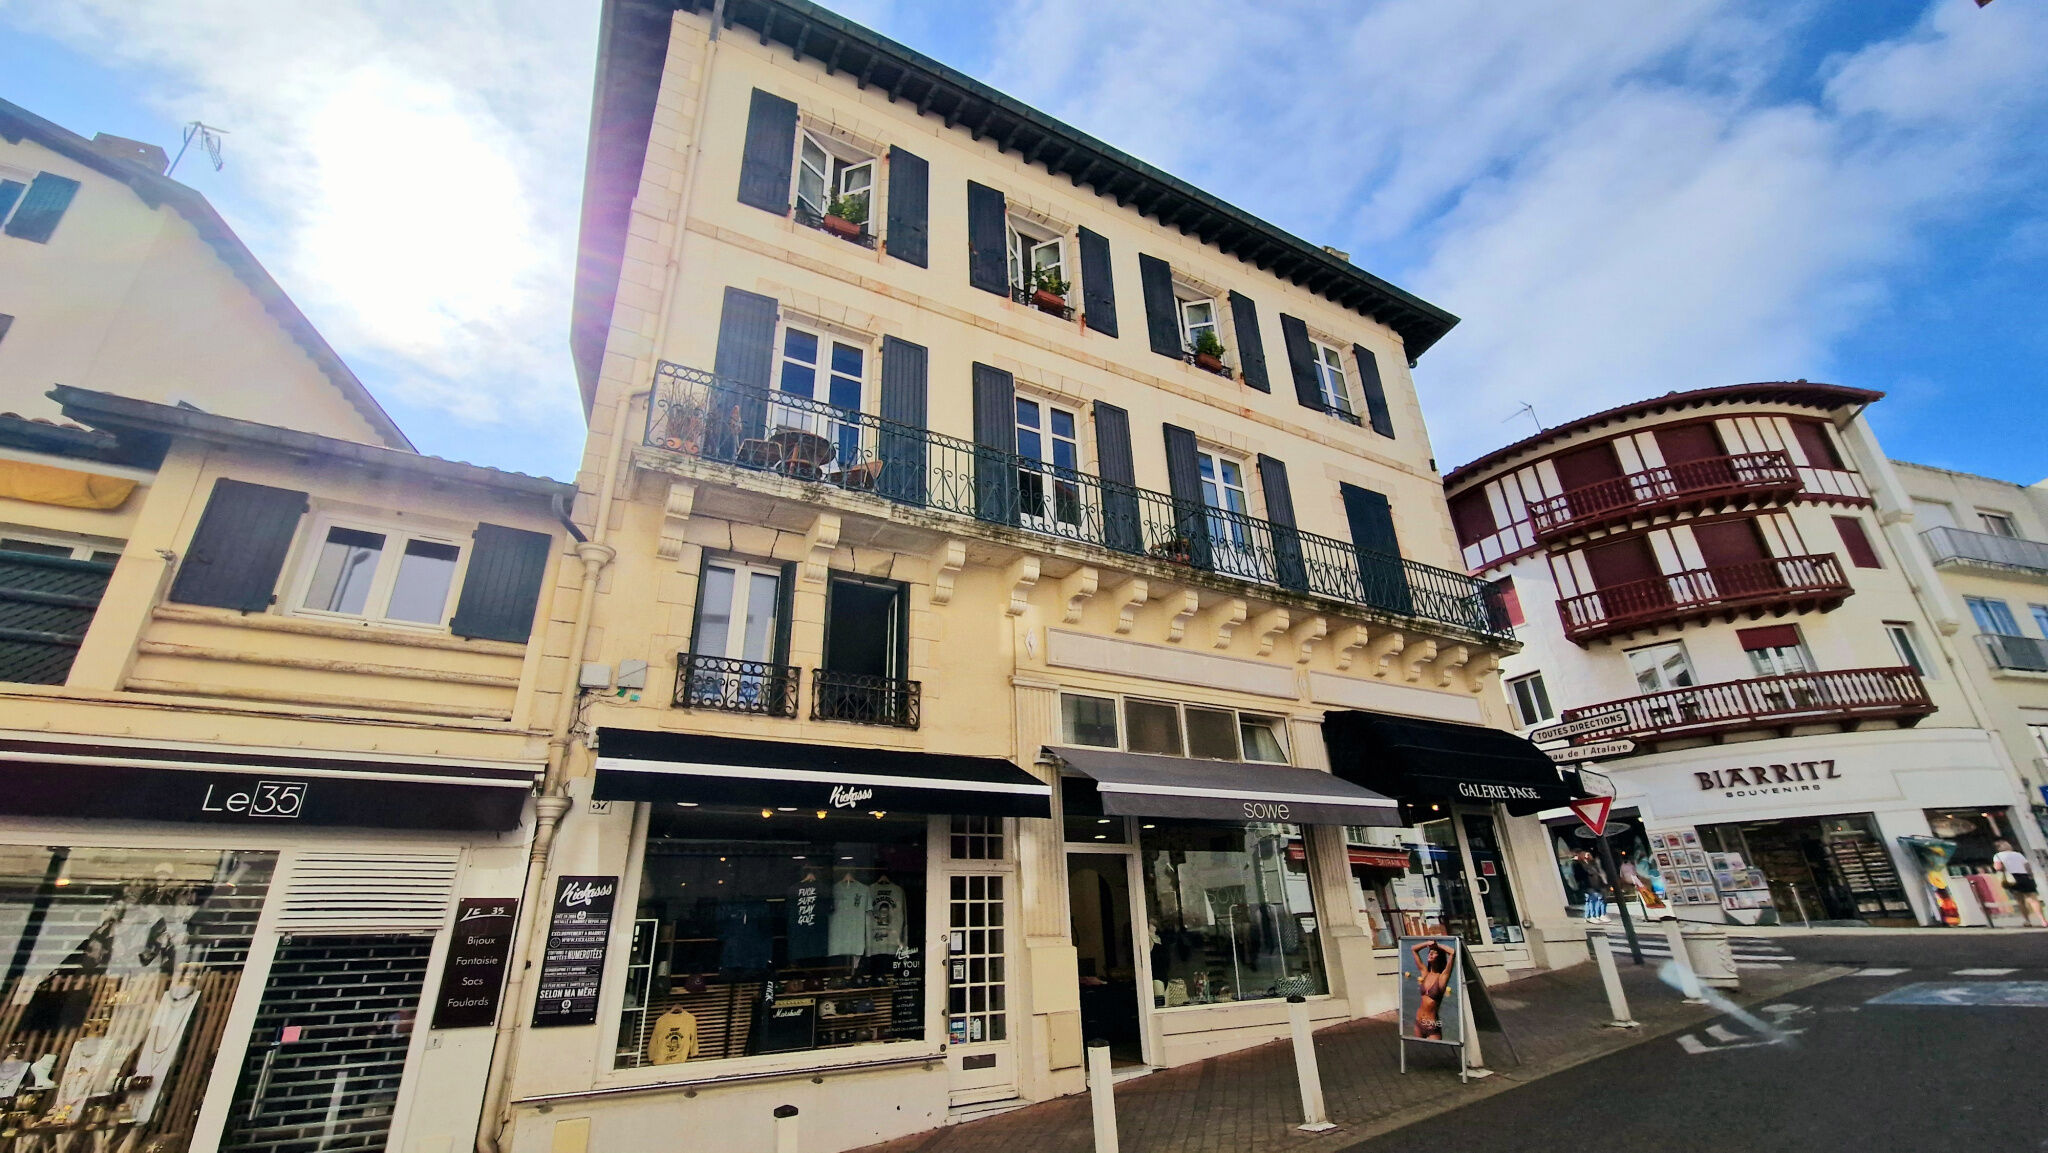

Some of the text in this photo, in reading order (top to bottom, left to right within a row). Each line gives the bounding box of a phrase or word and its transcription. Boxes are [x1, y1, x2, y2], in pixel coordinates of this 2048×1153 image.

[1537, 714, 1622, 739] TOUTES DIRECTIONS
[1568, 750, 1579, 758] de
[1694, 759, 1841, 791] BIARRITZ
[1459, 782, 1541, 799] GALERIE PAGE
[1726, 784, 1821, 798] SOUVENIRS
[202, 784, 301, 814] Le 35
[491, 907, 505, 916] 35
[798, 905, 815, 914] PLAY
[467, 936, 496, 947] Bijoux
[455, 956, 498, 966] Fantaisie
[892, 960, 920, 969] BY YOU!
[462, 976, 484, 986] Sacs
[540, 989, 563, 999] SELON
[564, 988, 576, 998] MA
[447, 997, 489, 1008] Foulards
[773, 1008, 803, 1019] Marshall
